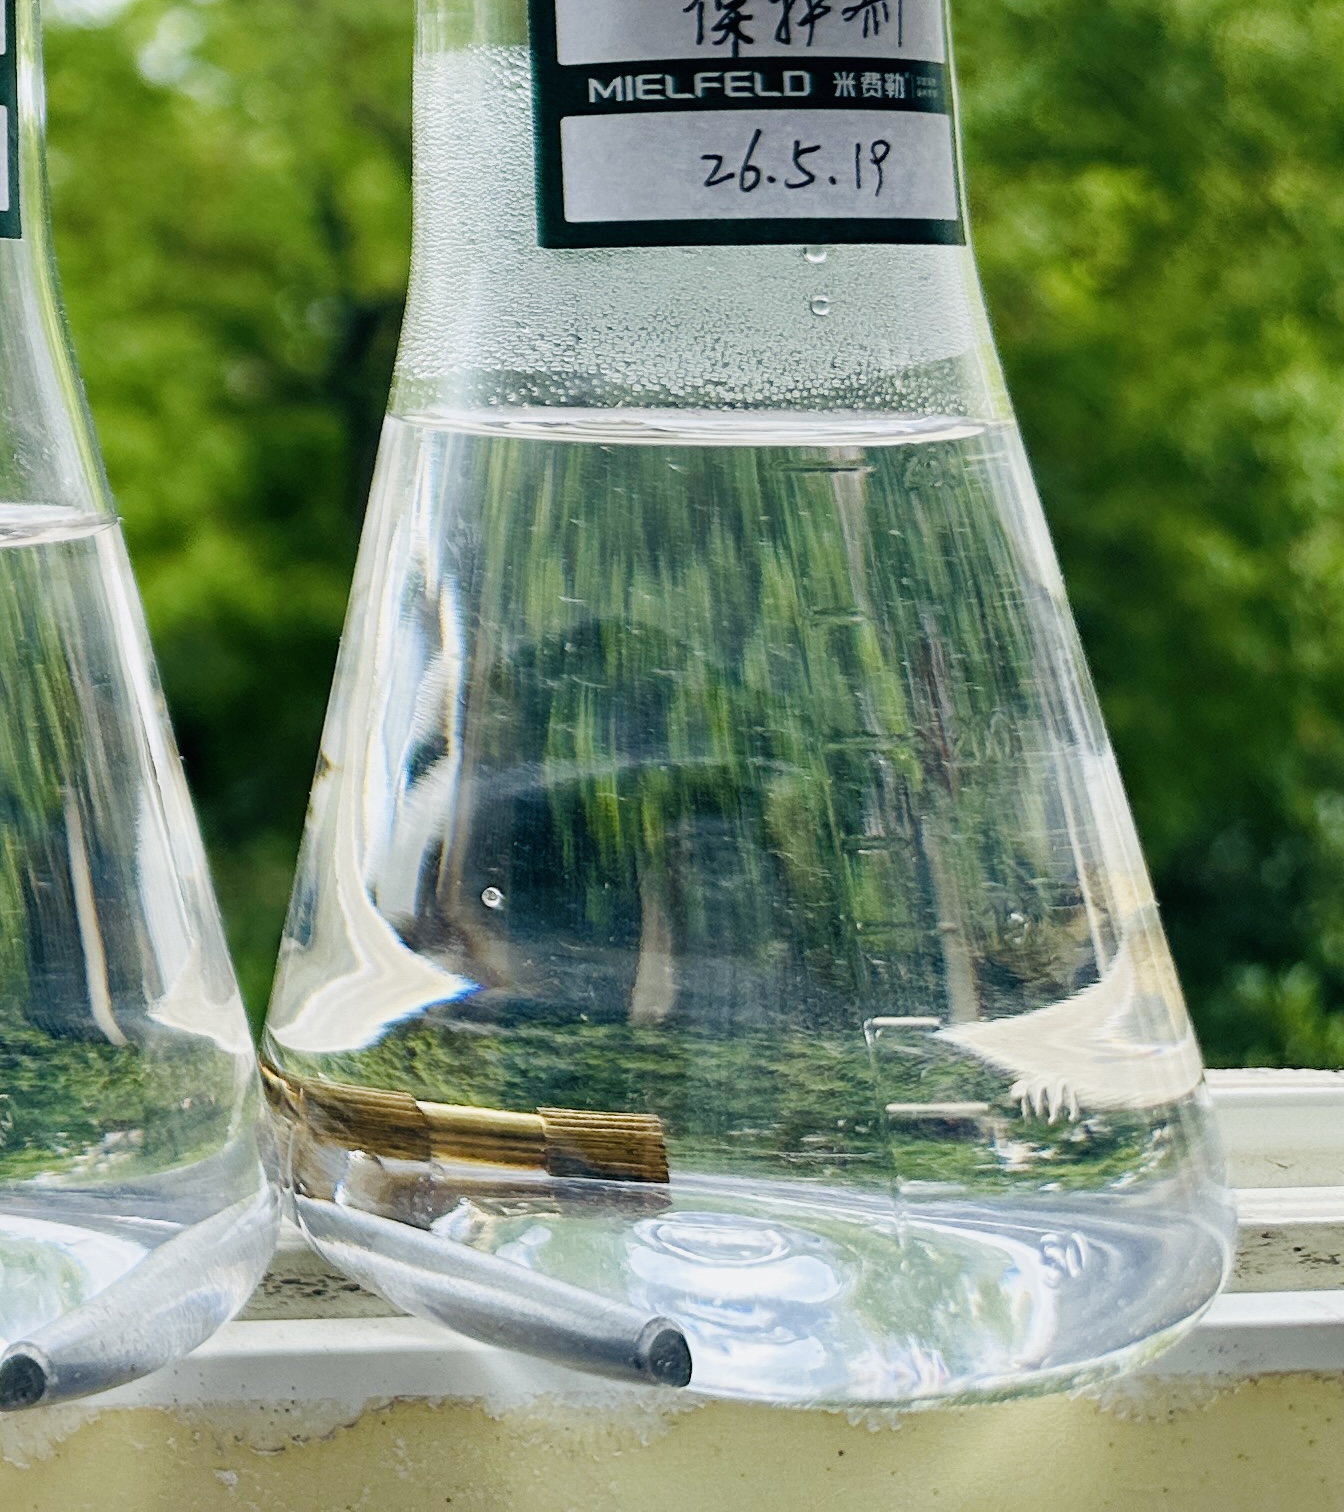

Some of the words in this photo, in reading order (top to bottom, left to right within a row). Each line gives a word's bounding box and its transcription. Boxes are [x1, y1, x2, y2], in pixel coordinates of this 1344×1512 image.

[587, 70, 812, 103] MIELFELD
[833, 71, 905, 99] 米费勒
[701, 128, 891, 197] 26.5.19
